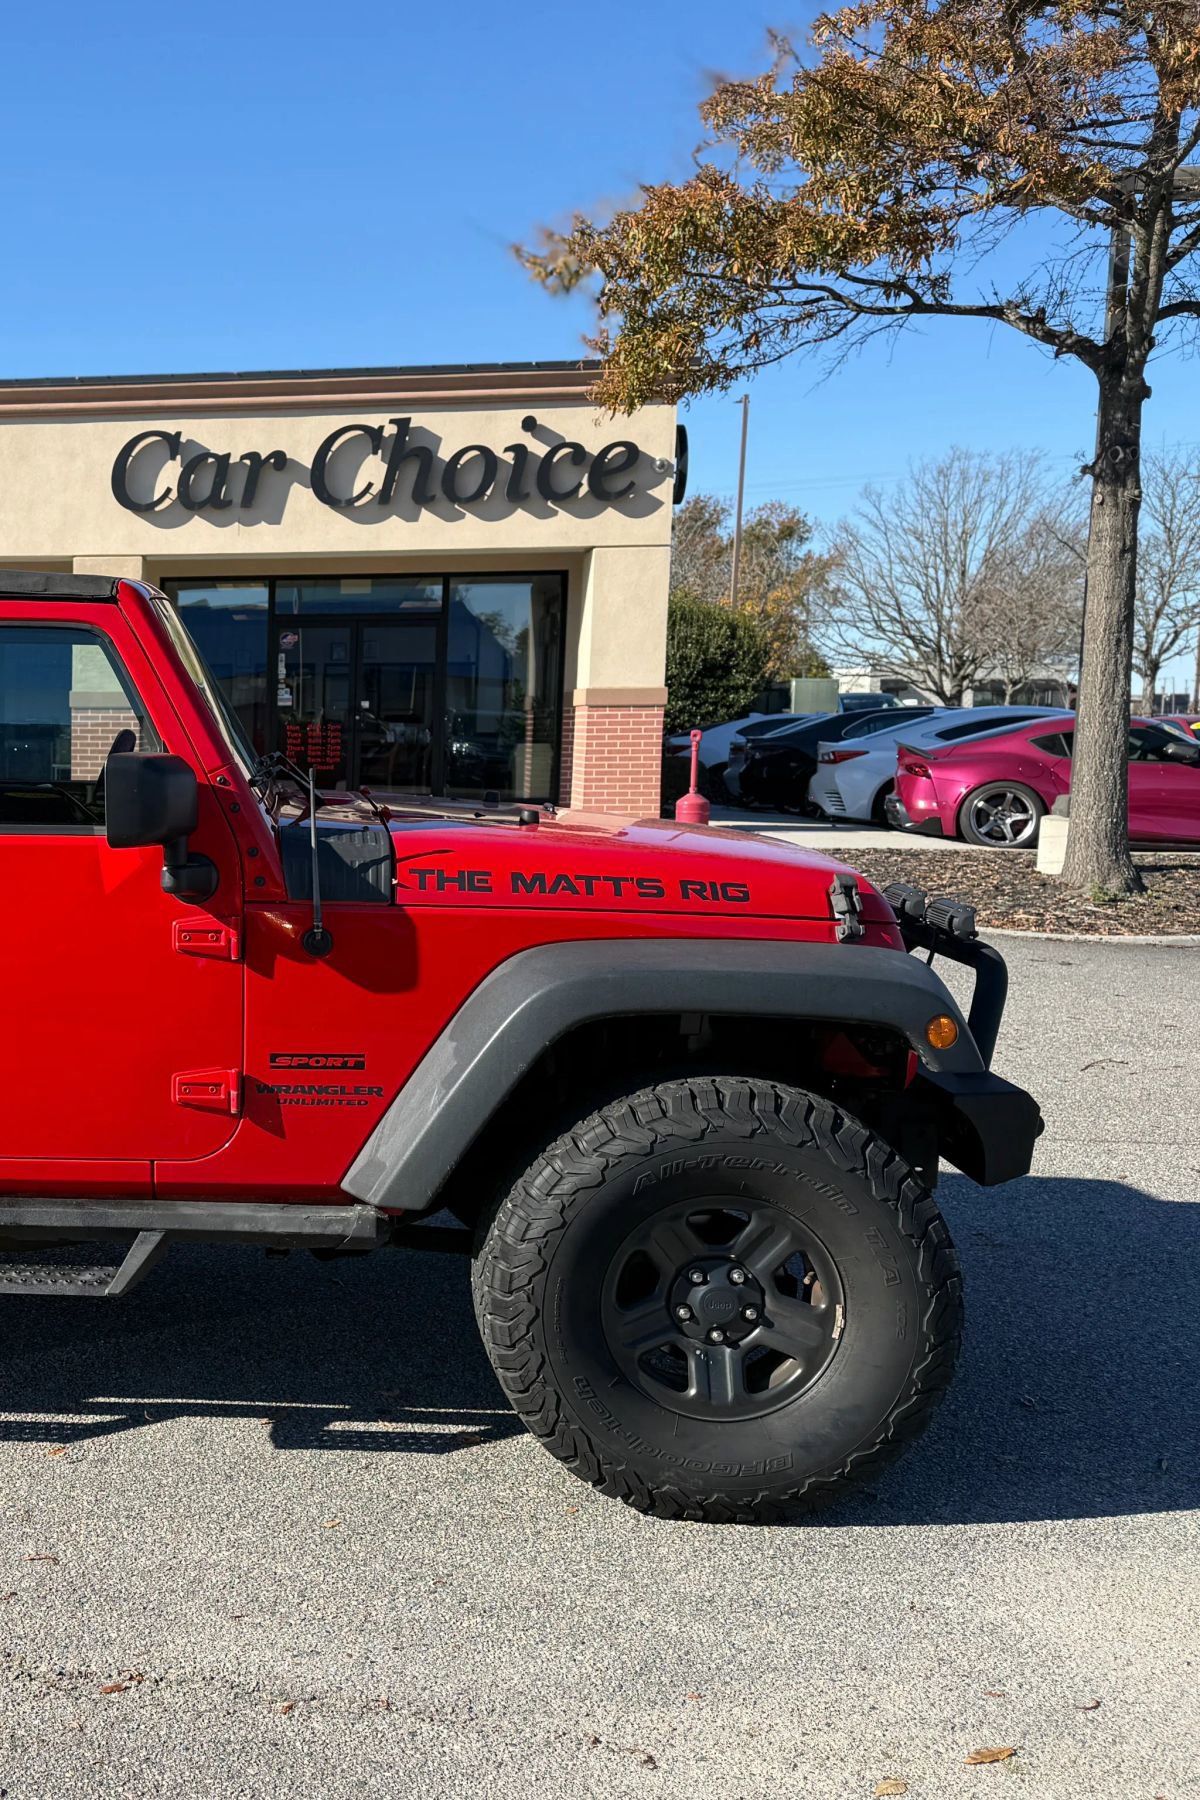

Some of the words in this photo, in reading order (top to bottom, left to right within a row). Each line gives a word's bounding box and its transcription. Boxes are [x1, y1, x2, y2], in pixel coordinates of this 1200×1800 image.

[110, 429, 288, 512] Car
[310, 415, 640, 508] Choice
[408, 868, 493, 893] THE
[510, 871, 666, 899] MATT'S
[679, 879, 751, 903] RIG
[270, 1055, 365, 1068] SPORT
[256, 1084, 385, 1097] WRANGLER
[276, 1098, 369, 1106] UNLIMITED
[632, 1154, 859, 1217] All-Terrain
[573, 1375, 795, 1478] BFGoodrich
